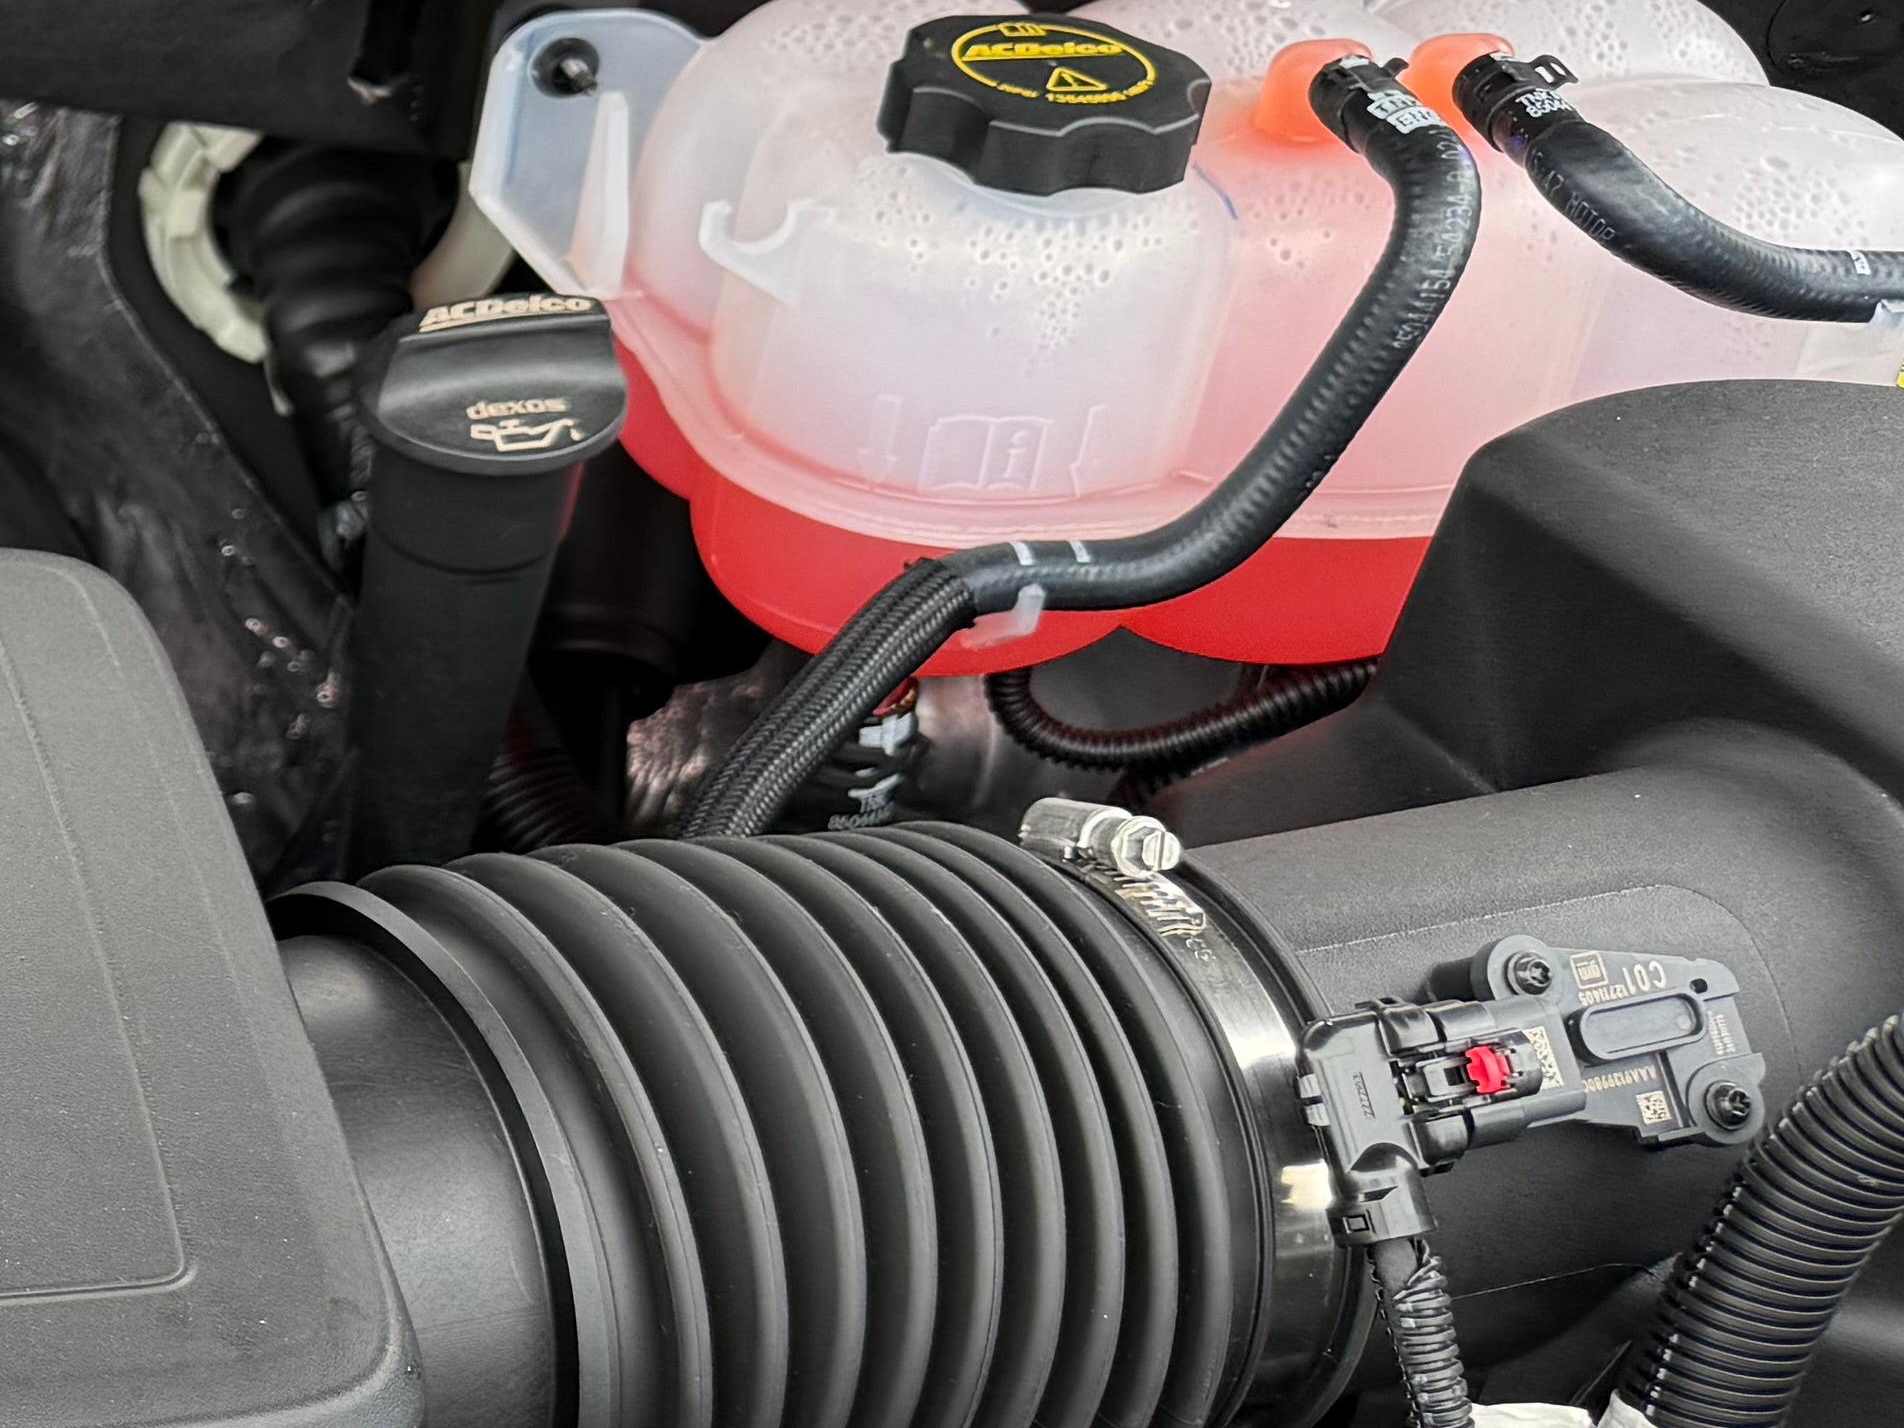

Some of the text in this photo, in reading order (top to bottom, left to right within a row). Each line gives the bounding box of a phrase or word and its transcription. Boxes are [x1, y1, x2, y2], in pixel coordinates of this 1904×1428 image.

[962, 41, 1123, 62] ACDelco
[418, 294, 594, 333] ACDelco
[465, 396, 572, 420] dexos
